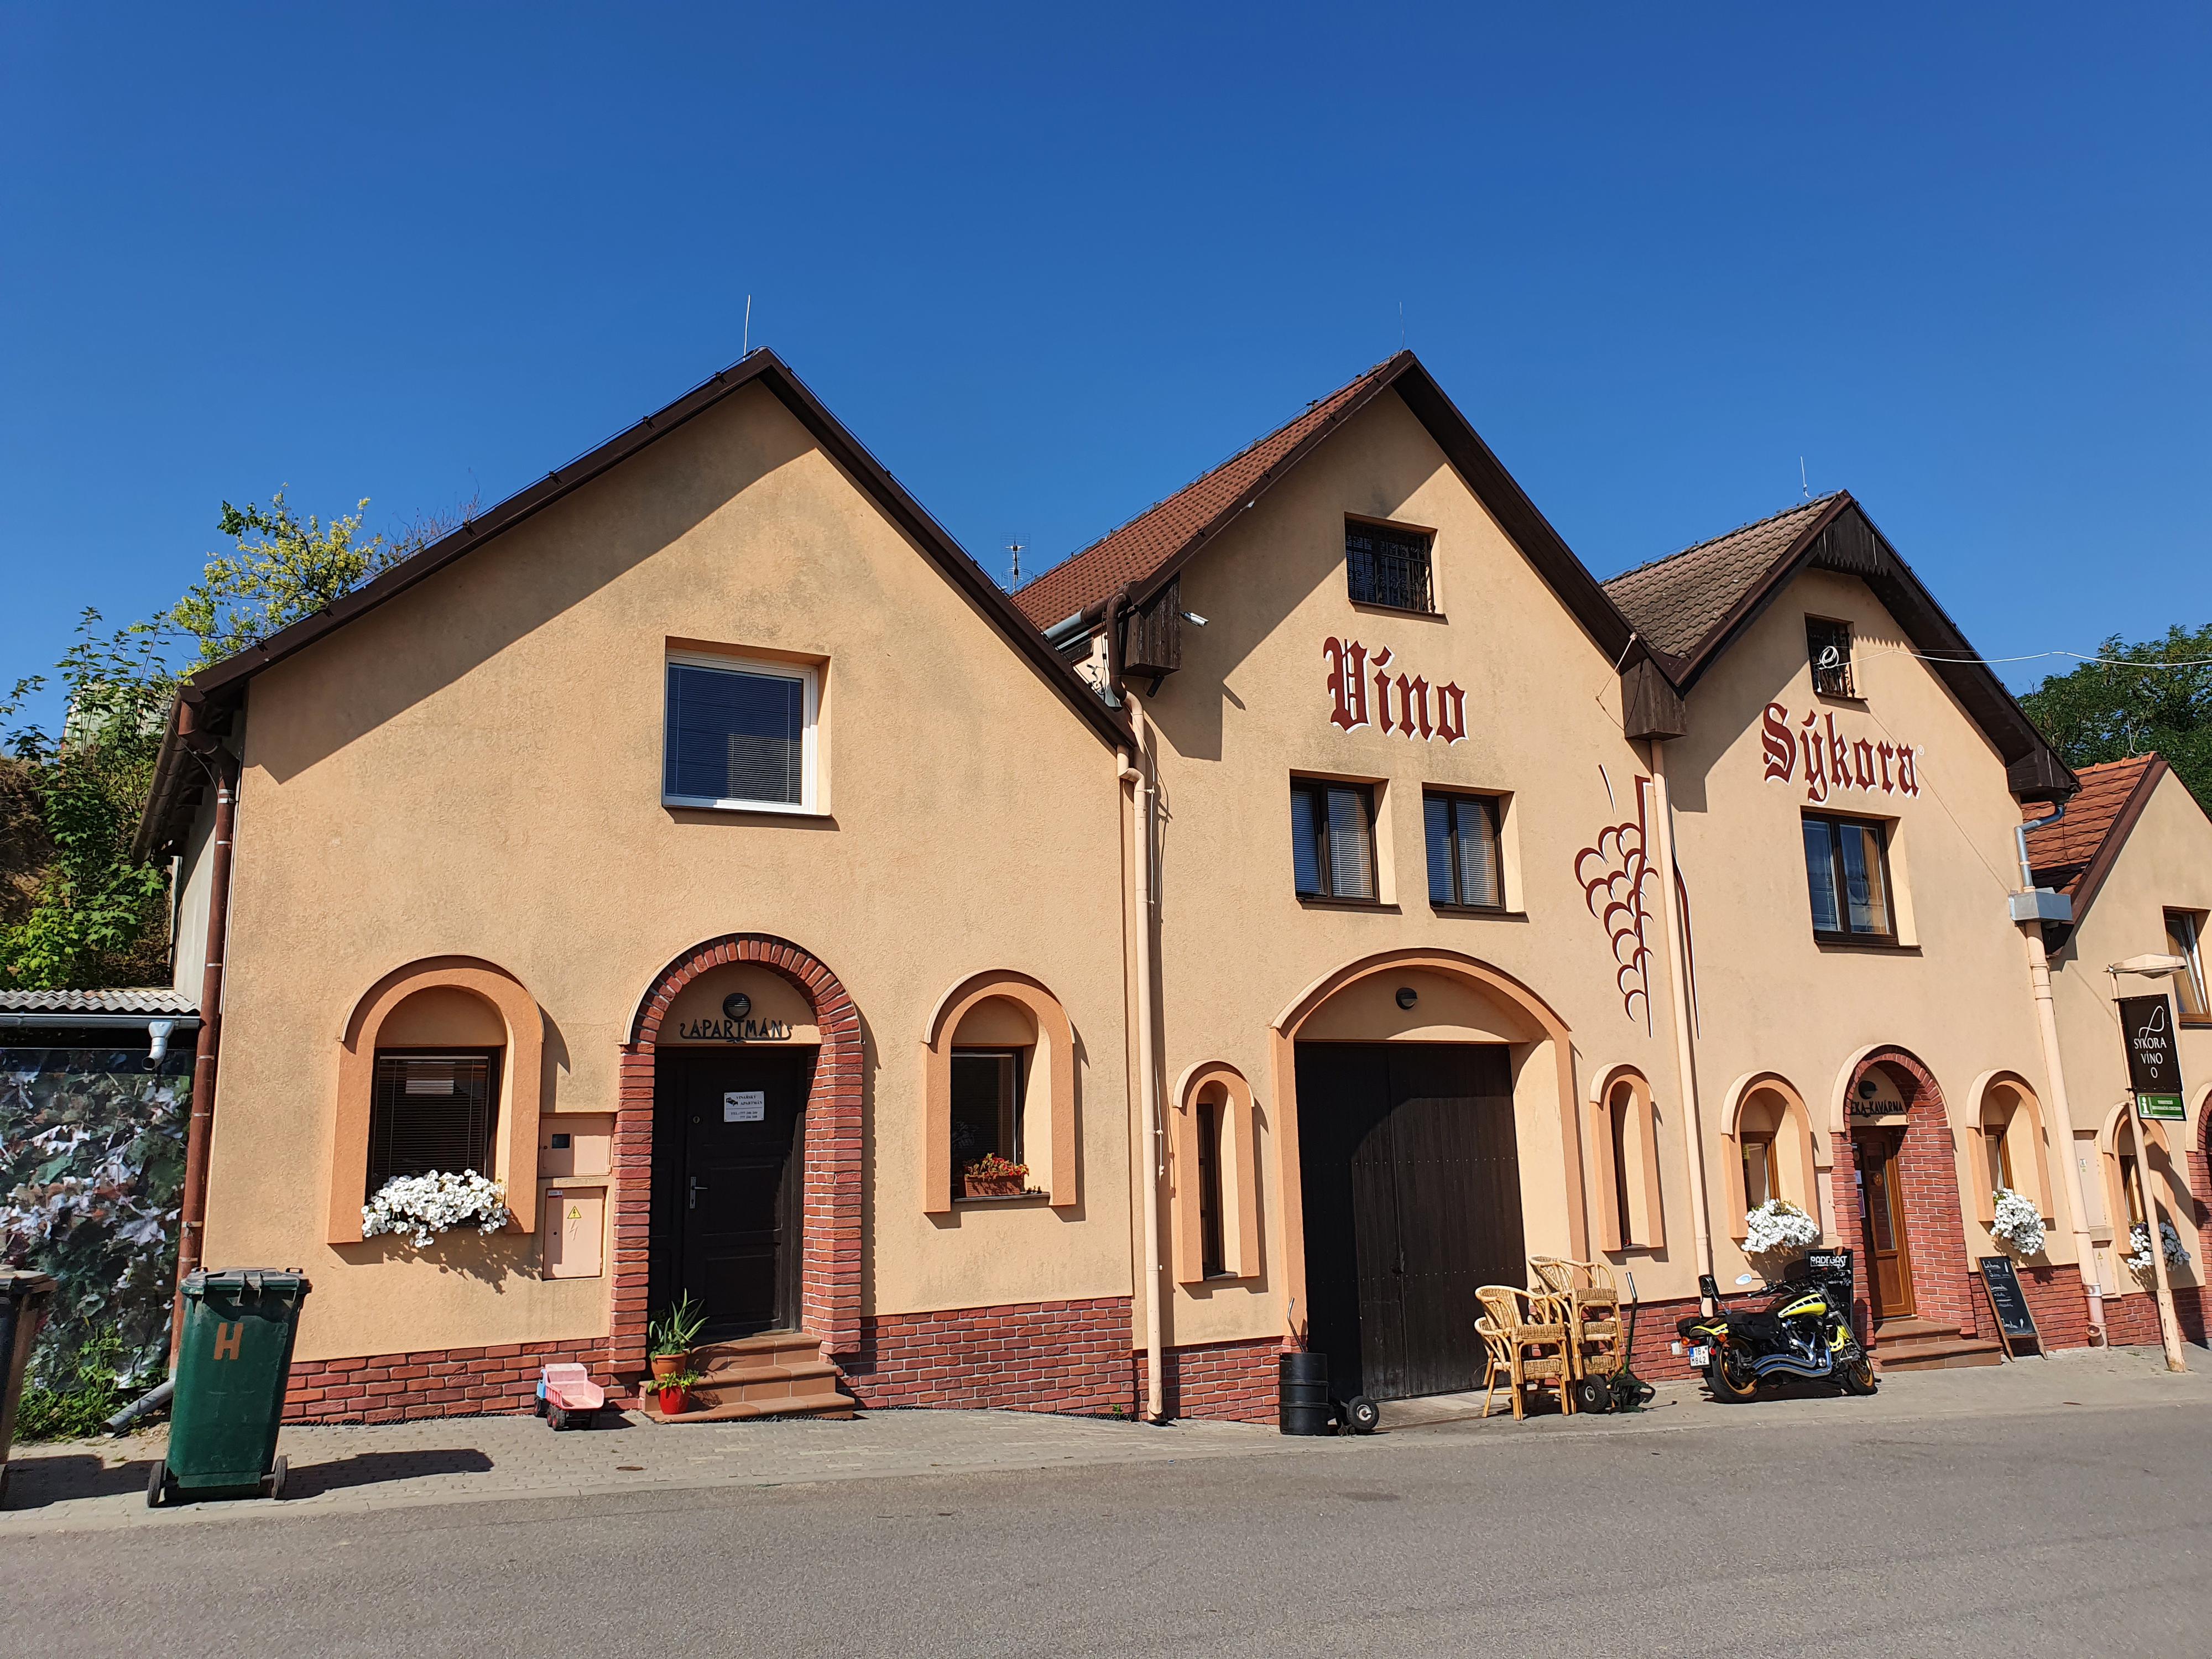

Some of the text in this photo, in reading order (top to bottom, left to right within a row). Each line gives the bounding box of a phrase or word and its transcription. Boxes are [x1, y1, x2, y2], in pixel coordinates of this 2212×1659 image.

[1323, 637, 1469, 747] Víno
[1761, 702, 1921, 805] Sýkora
[690, 1018, 782, 1038] APARTMÁN
[2140, 1050, 2163, 1065] VÍNO
[1810, 1256, 1847, 1267] RADEGAST
[213, 1322, 243, 1360] H
